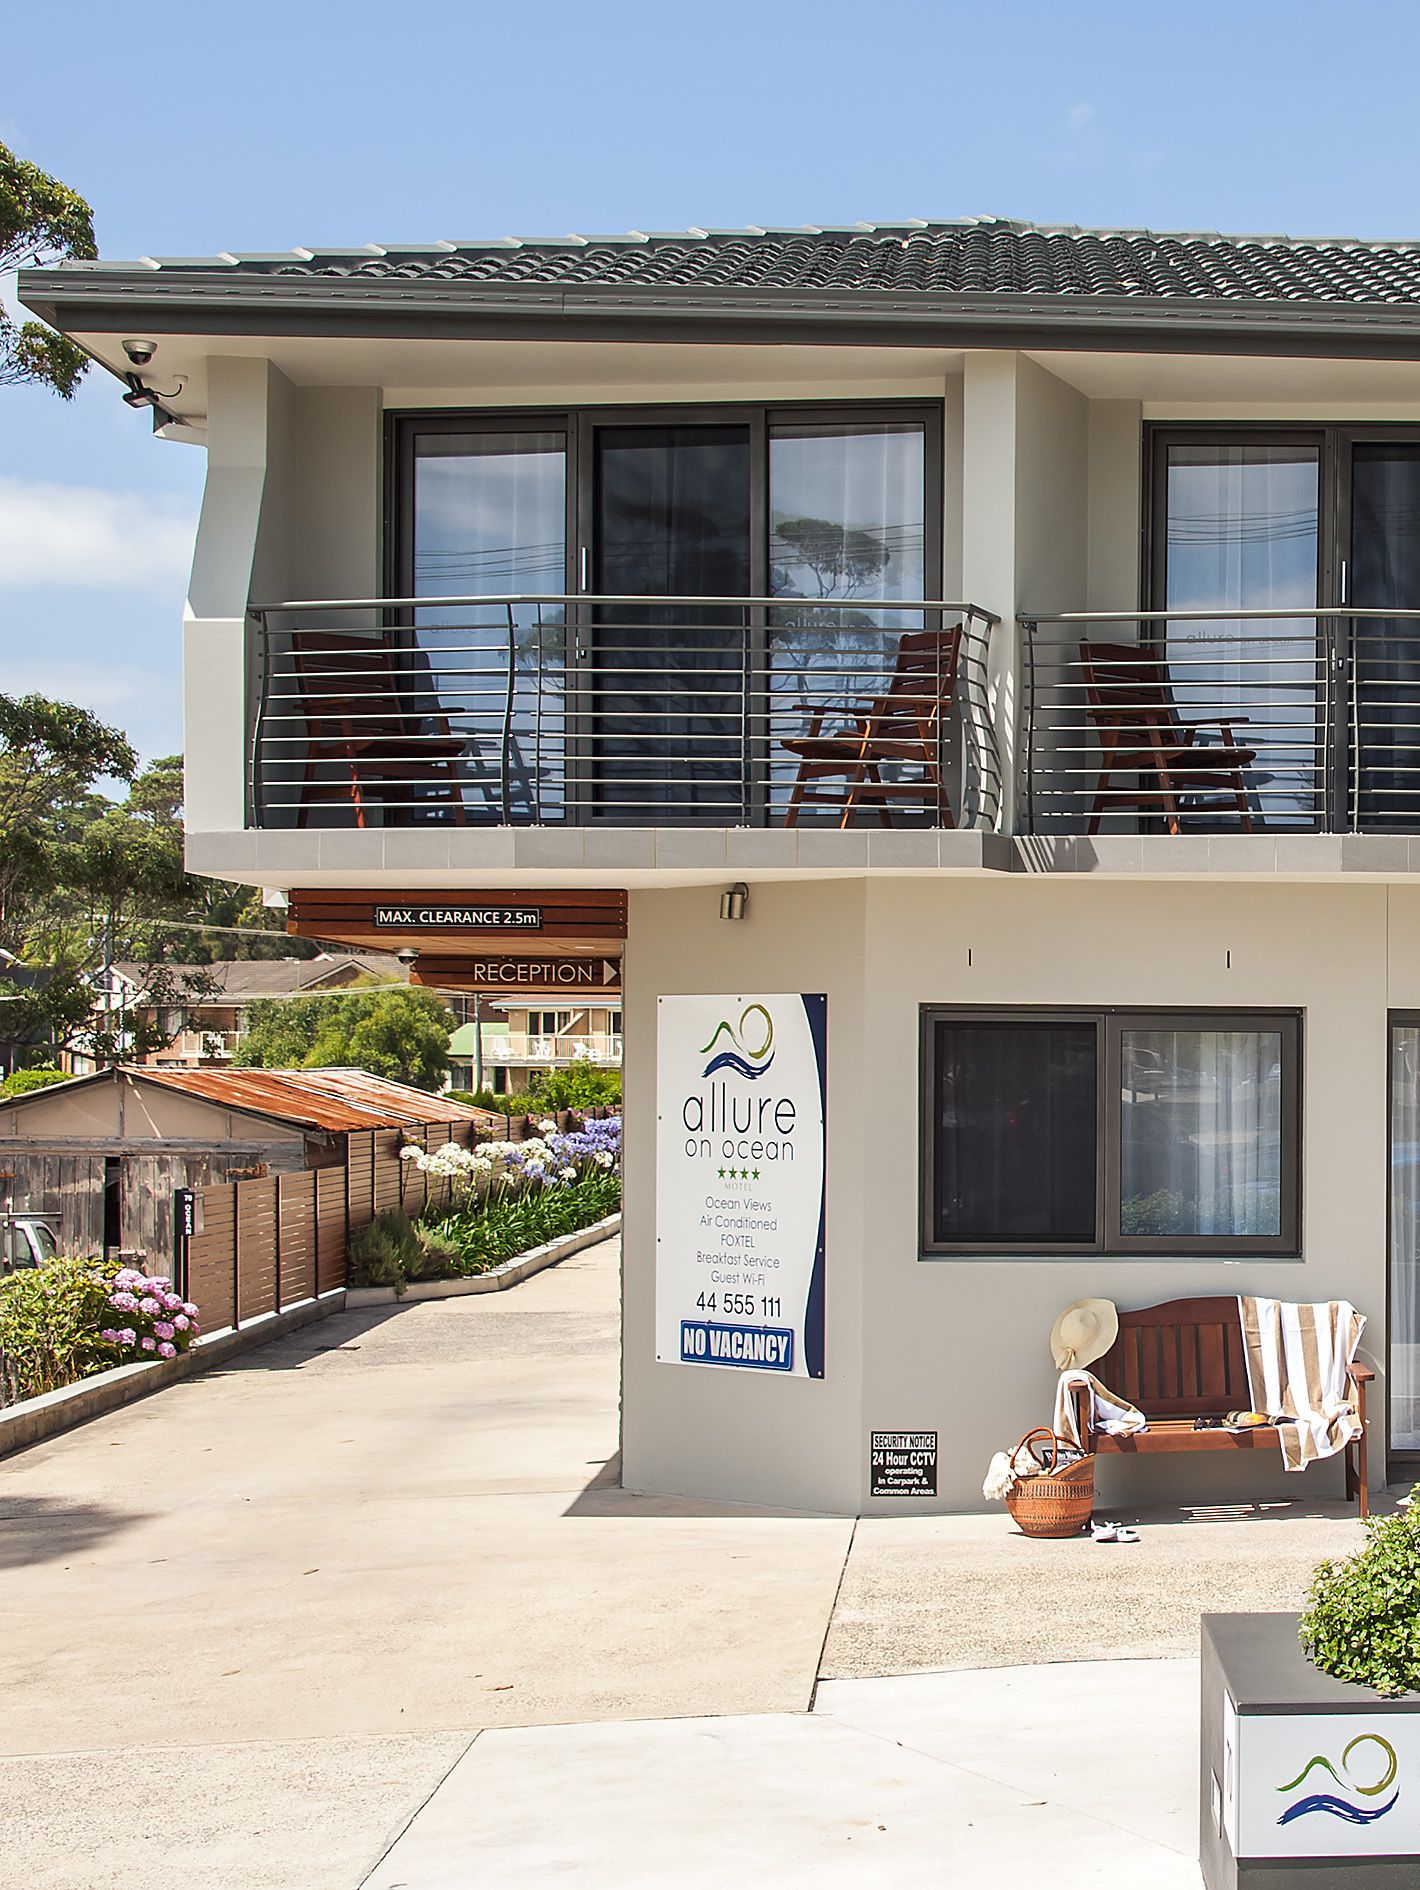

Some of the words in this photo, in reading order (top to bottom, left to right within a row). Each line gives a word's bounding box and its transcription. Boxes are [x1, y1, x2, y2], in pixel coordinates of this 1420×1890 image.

[379, 911, 416, 924] MAX.
[420, 911, 500, 924] CLEARANCE
[503, 911, 537, 924] 2.5m
[474, 963, 592, 983] RECEPTION
[683, 1082, 796, 1134] allure
[685, 1139, 711, 1157] on
[722, 1140, 793, 1160] ocean
[725, 1183, 752, 1191] MOTEL
[705, 1196, 740, 1210] Ocean
[743, 1199, 772, 1212] Views
[700, 1215, 713, 1226] Air
[715, 1215, 777, 1231] Conditioned
[721, 1234, 755, 1248] FOXTEL
[697, 1251, 741, 1266] Breakfast
[744, 1254, 780, 1269] Service
[711, 1271, 740, 1284] Guest
[743, 1273, 765, 1286] Wi-Fi
[696, 1292, 717, 1311] 44
[723, 1294, 755, 1315] 555
[761, 1297, 781, 1317] 111
[683, 1328, 706, 1356] NO
[709, 1330, 788, 1363] VACANCY
[874, 1435, 908, 1448] SECURITY
[909, 1435, 935, 1448] NOTICE
[872, 1451, 884, 1466] 24
[886, 1451, 909, 1466] Hour
[910, 1451, 936, 1466] CCTV
[884, 1467, 923, 1476] operating
[887, 1477, 920, 1486] Carpark
[921, 1477, 928, 1485] &
[873, 1487, 909, 1495] Common
[910, 1487, 935, 1495] Areas
